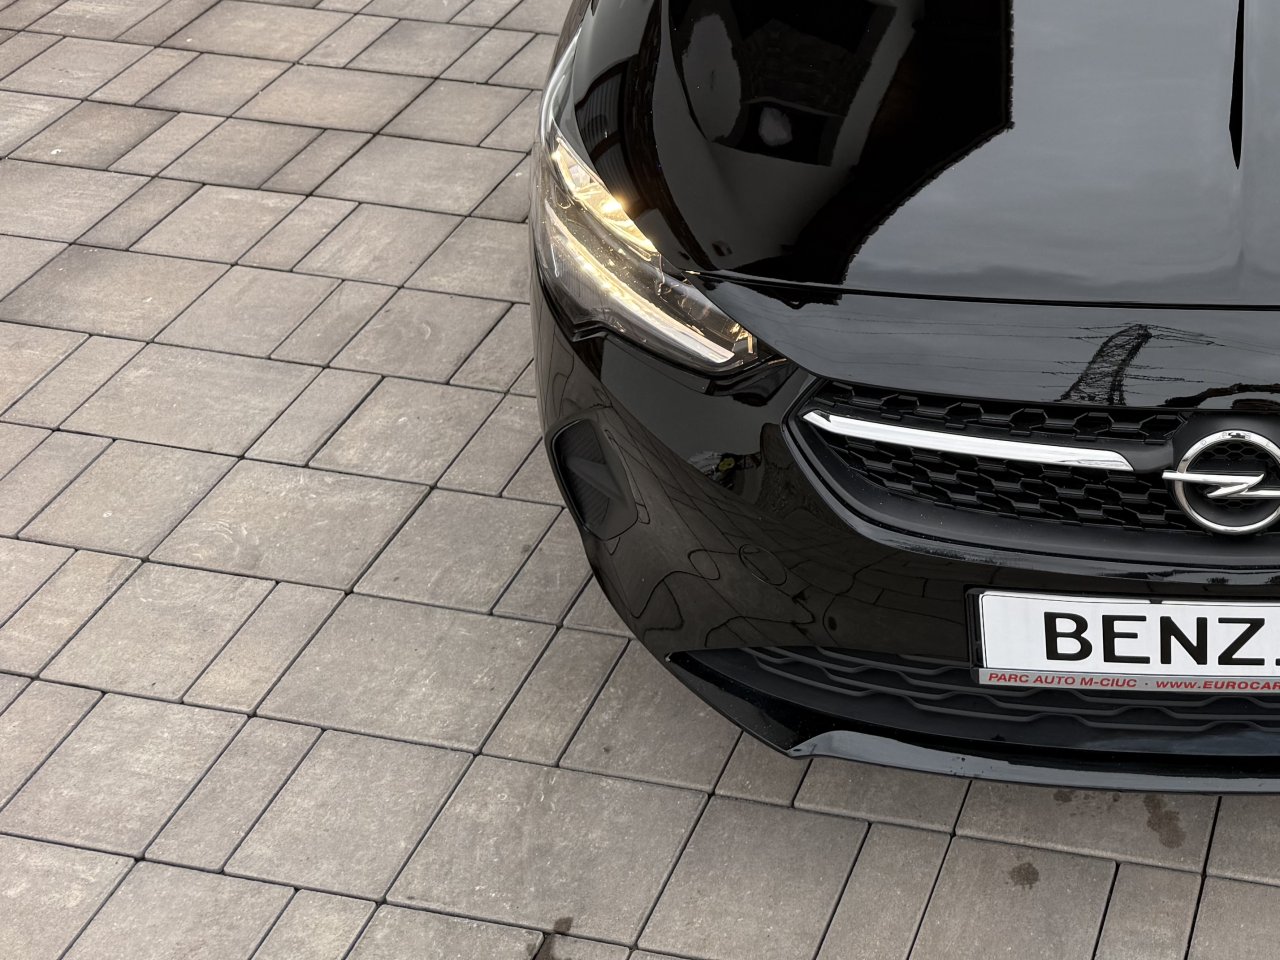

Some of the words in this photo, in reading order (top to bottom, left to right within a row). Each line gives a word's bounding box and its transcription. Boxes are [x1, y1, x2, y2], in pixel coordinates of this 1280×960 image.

[988, 672, 1030, 684] PARC
[1032, 674, 1076, 686] AUTO
[1080, 676, 1138, 688] M-CIUC
